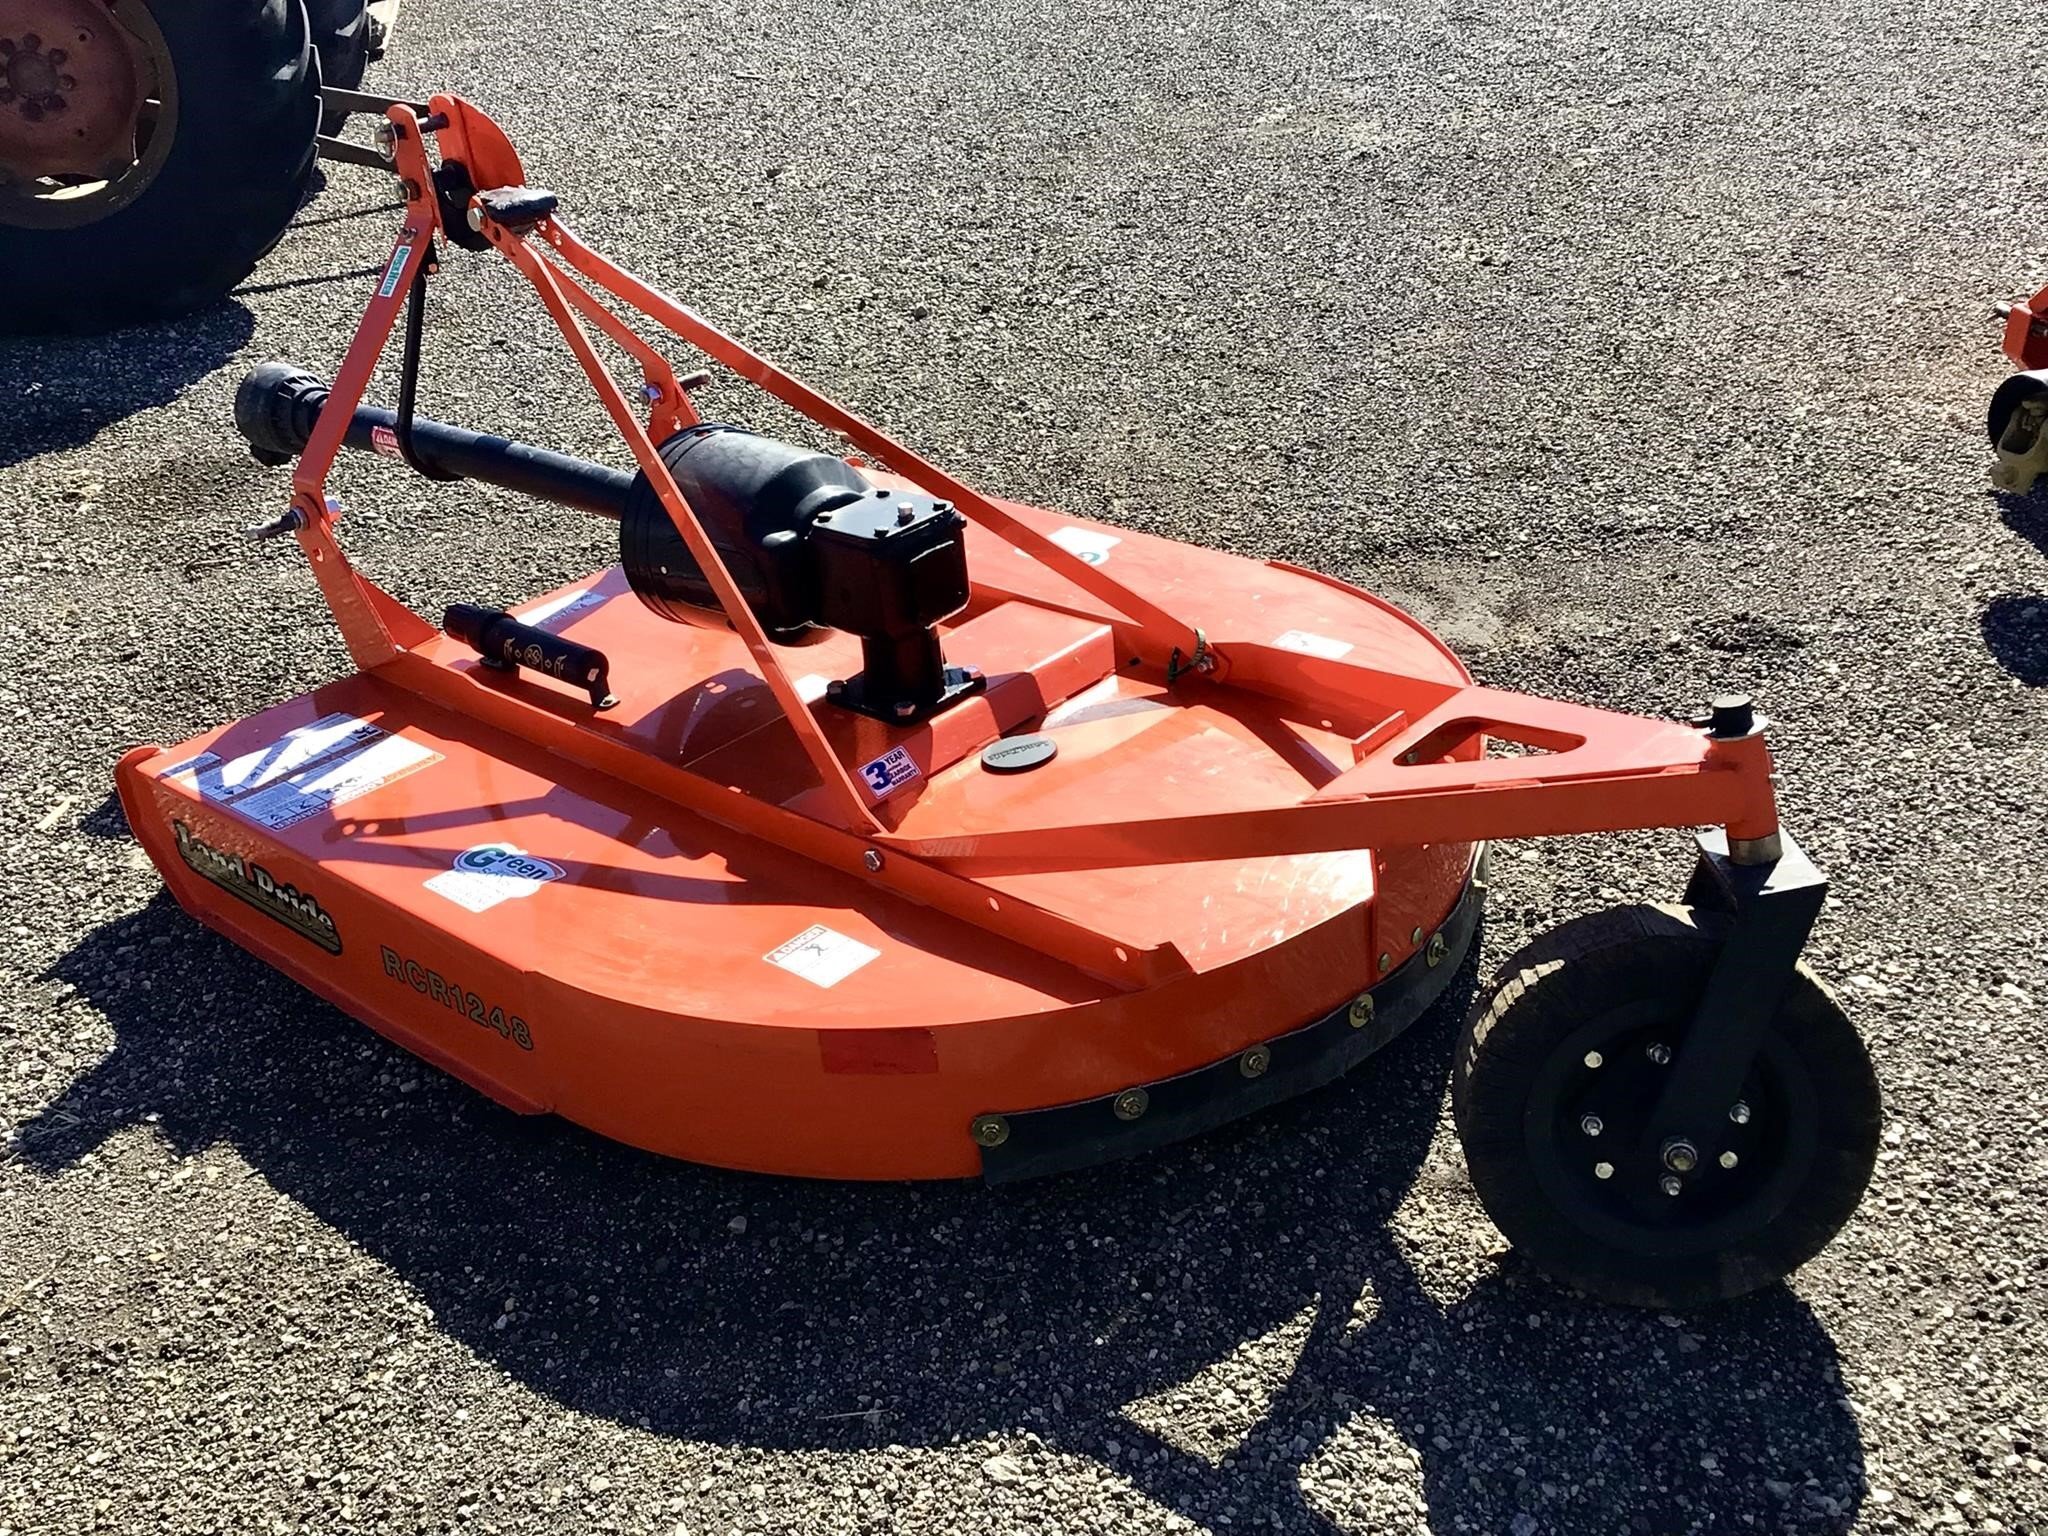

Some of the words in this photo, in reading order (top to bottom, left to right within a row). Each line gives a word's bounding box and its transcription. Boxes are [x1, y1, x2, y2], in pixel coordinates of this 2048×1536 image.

[865, 761, 892, 790] 3
[884, 750, 906, 766] YEAR
[890, 768, 918, 786] WARRANTY
[273, 802, 322, 831] DANGER
[174, 820, 247, 884] Land
[250, 863, 338, 940] Pride
[463, 846, 549, 881] Green
[381, 944, 535, 1051] RCR1248
